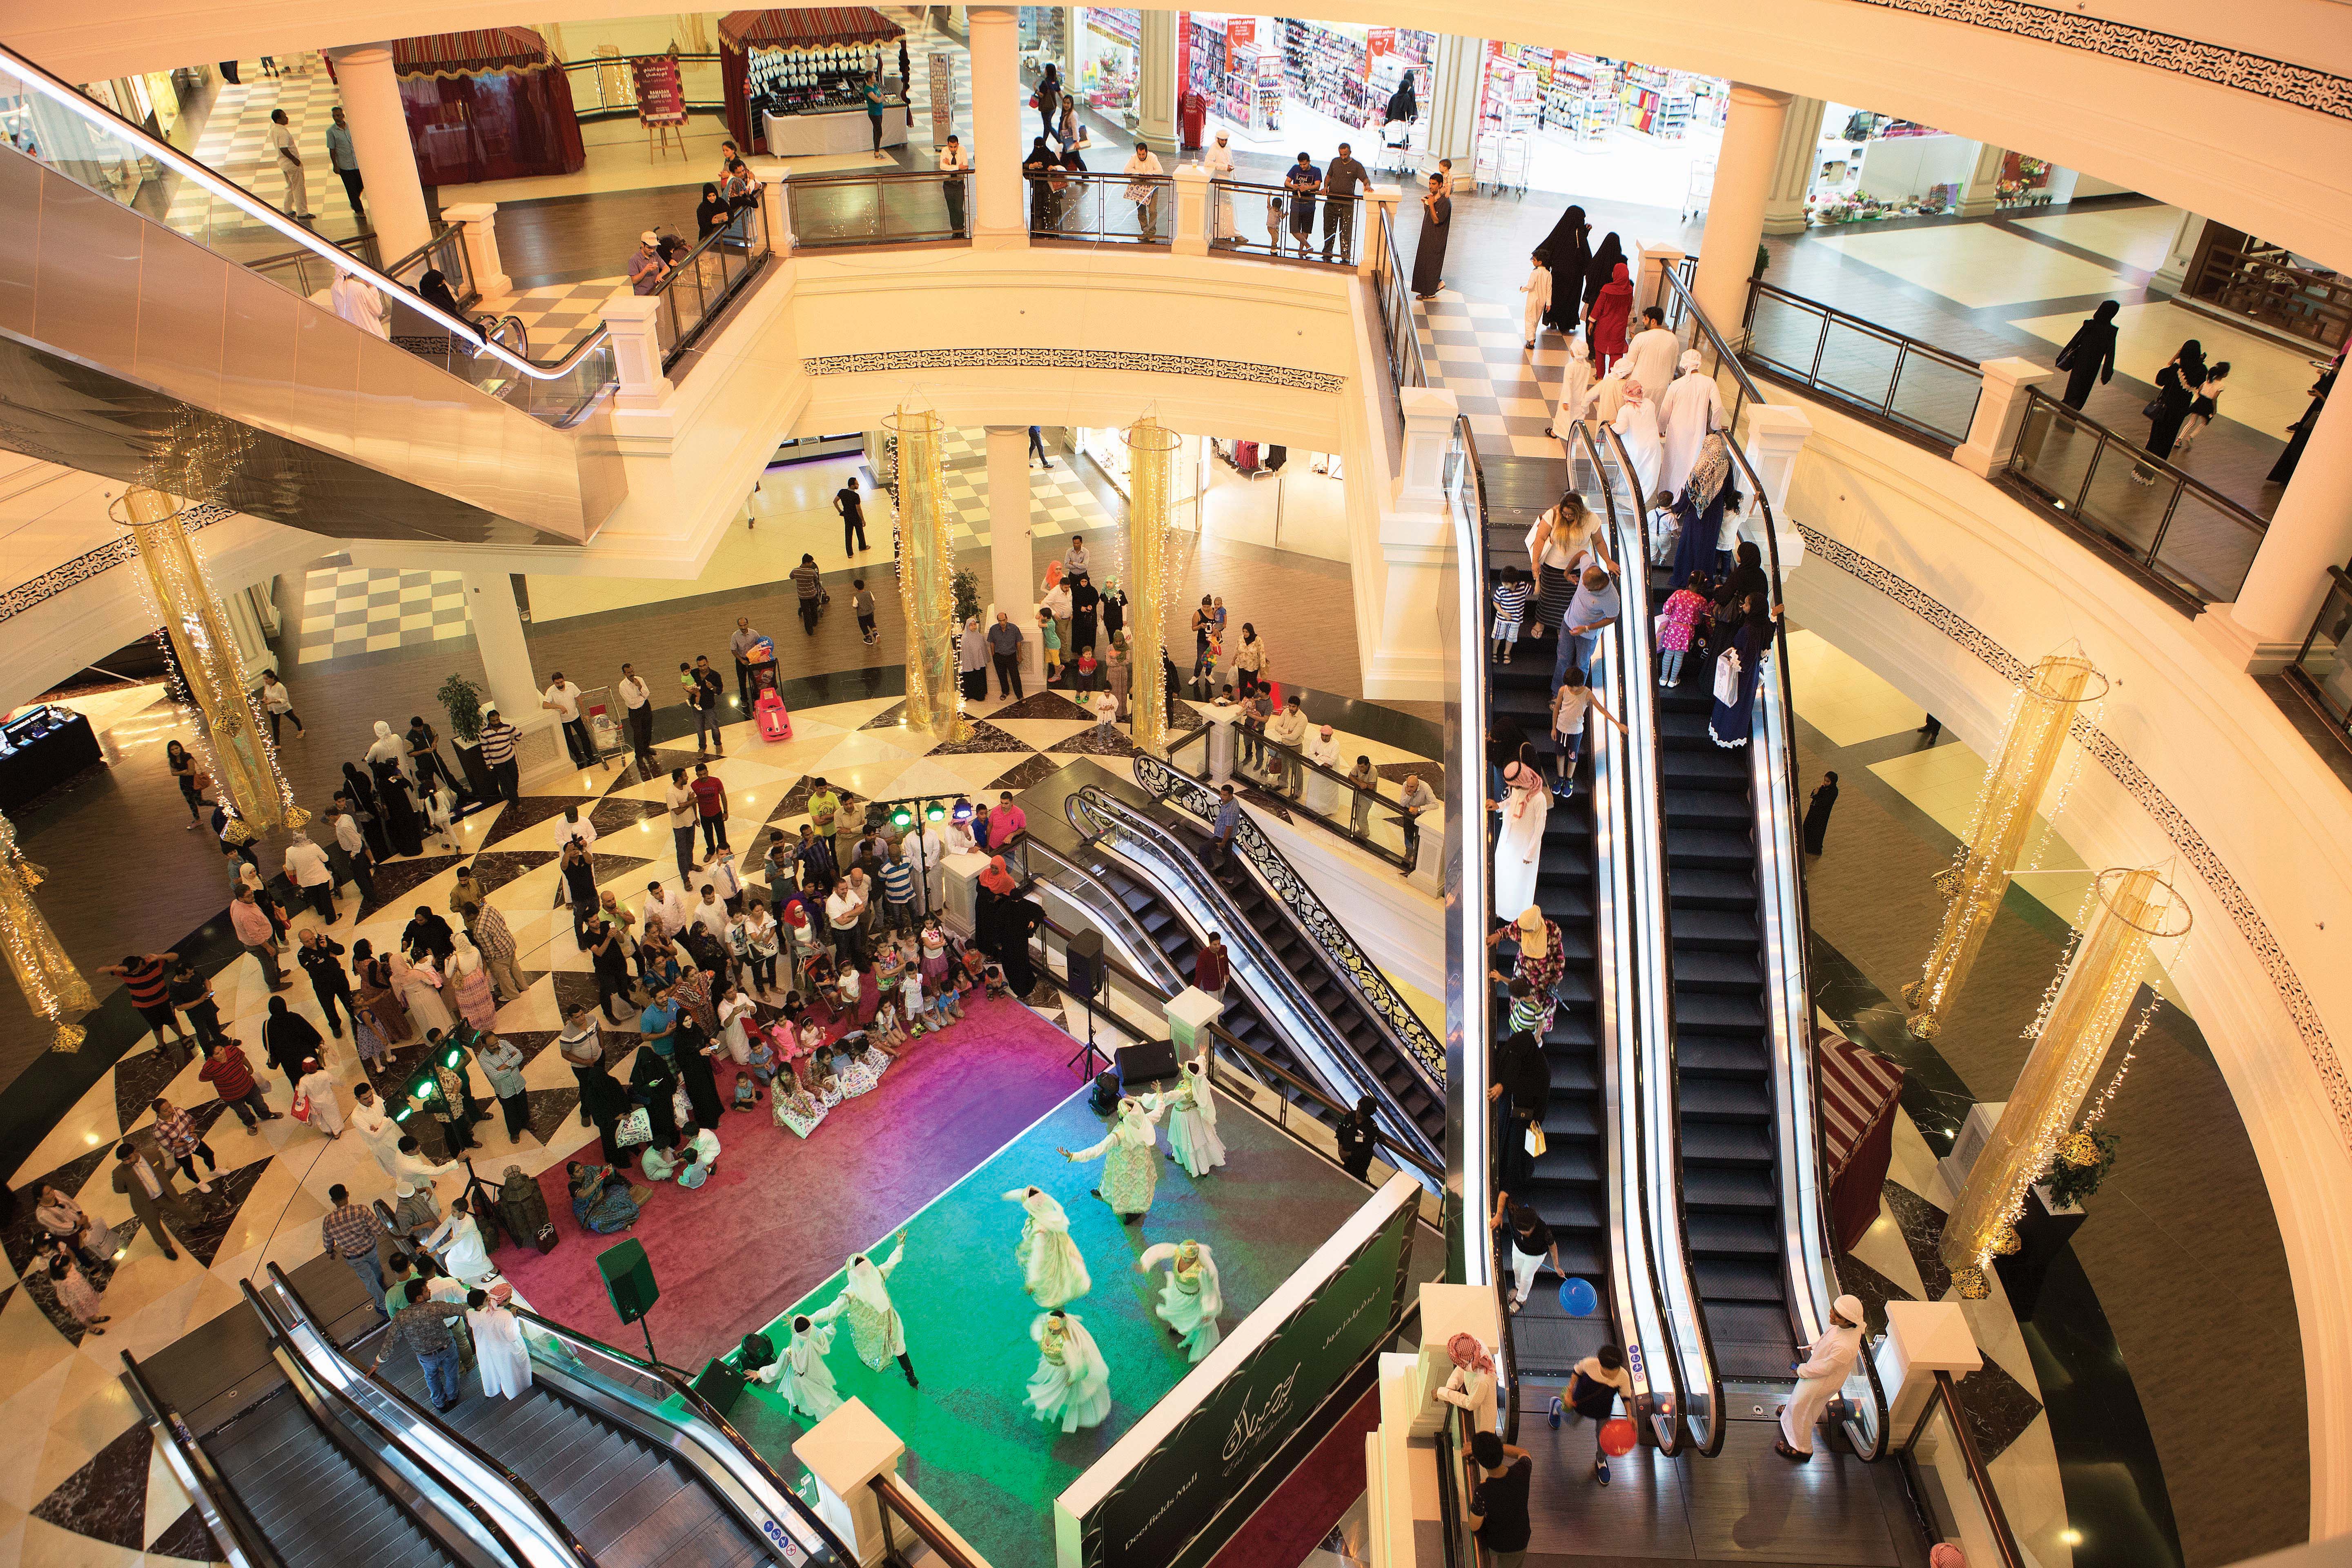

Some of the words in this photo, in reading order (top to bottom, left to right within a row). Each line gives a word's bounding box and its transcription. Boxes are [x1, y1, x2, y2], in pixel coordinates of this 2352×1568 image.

[1222, 1449, 1247, 1477] Eid
[1125, 1498, 1174, 1551] Deerfields
[1176, 1471, 1198, 1500] Mall
